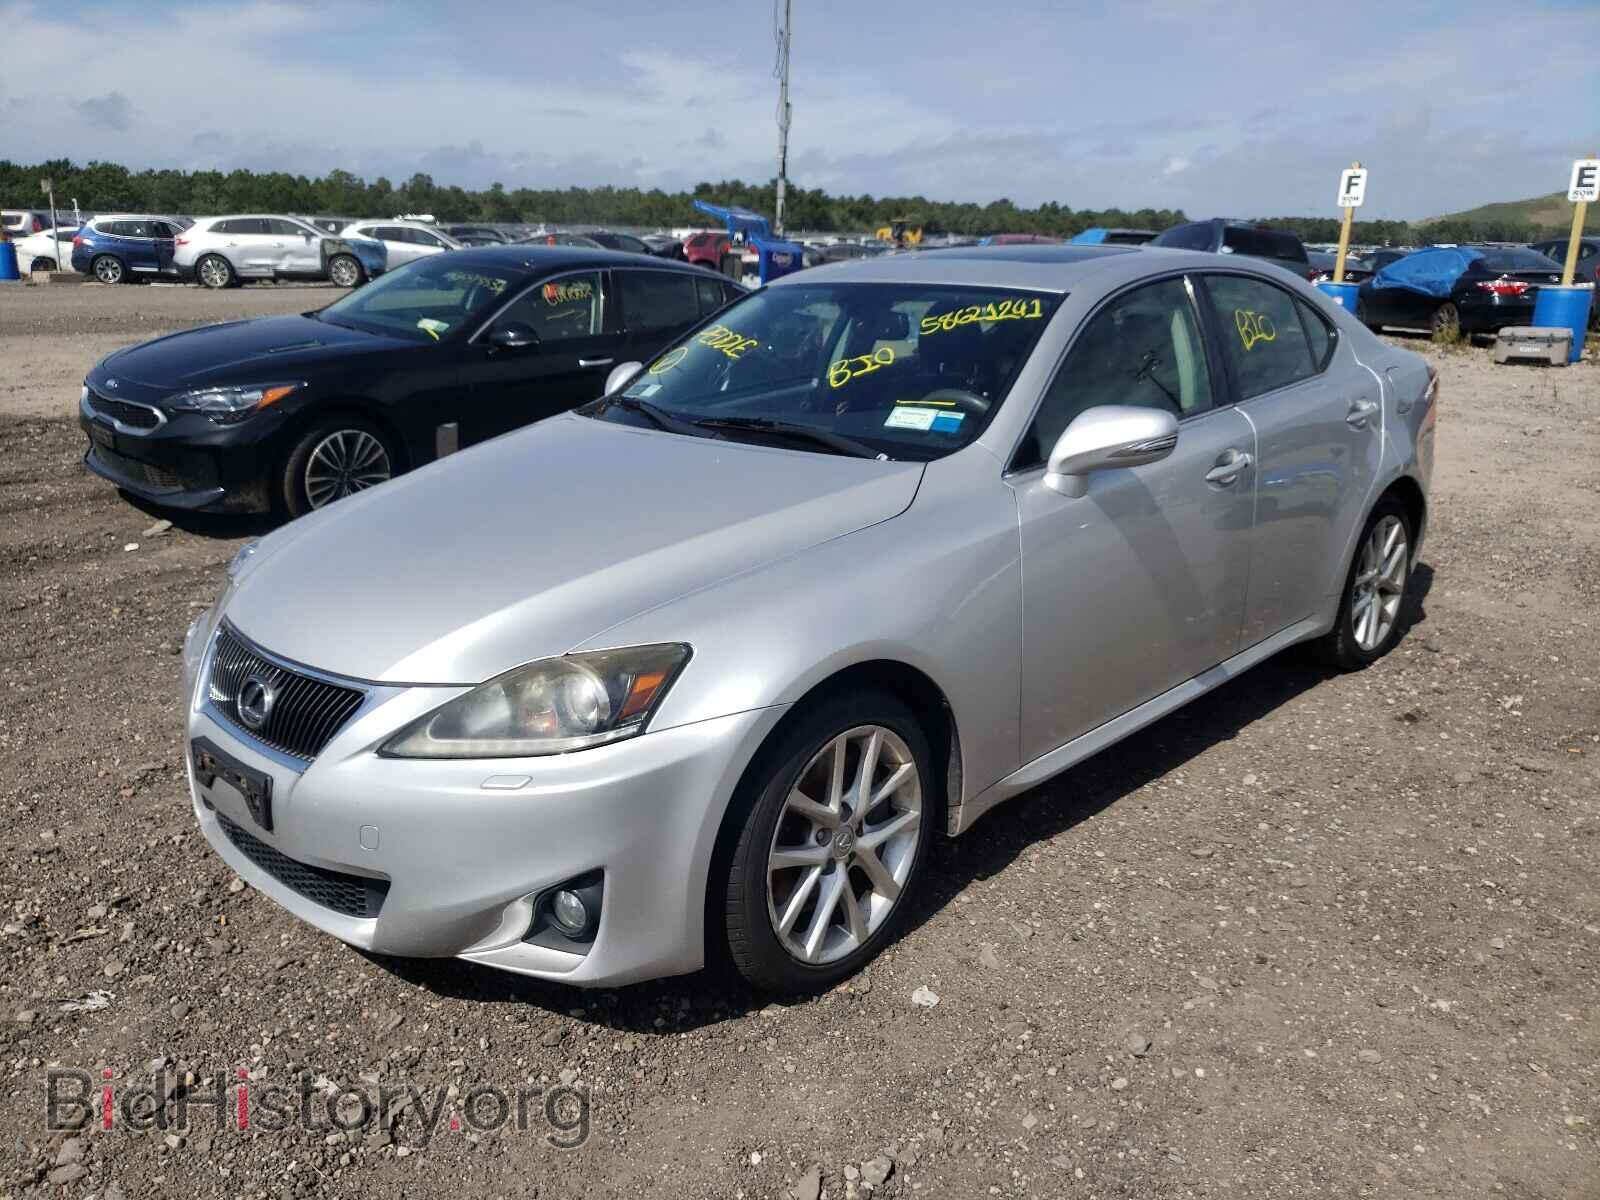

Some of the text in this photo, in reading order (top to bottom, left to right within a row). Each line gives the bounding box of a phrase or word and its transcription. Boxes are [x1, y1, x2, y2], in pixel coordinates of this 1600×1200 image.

[1345, 175, 1361, 194] F
[1576, 166, 1597, 188] E
[919, 298, 1043, 335] 58621241
[1234, 308, 1276, 351] BIO
